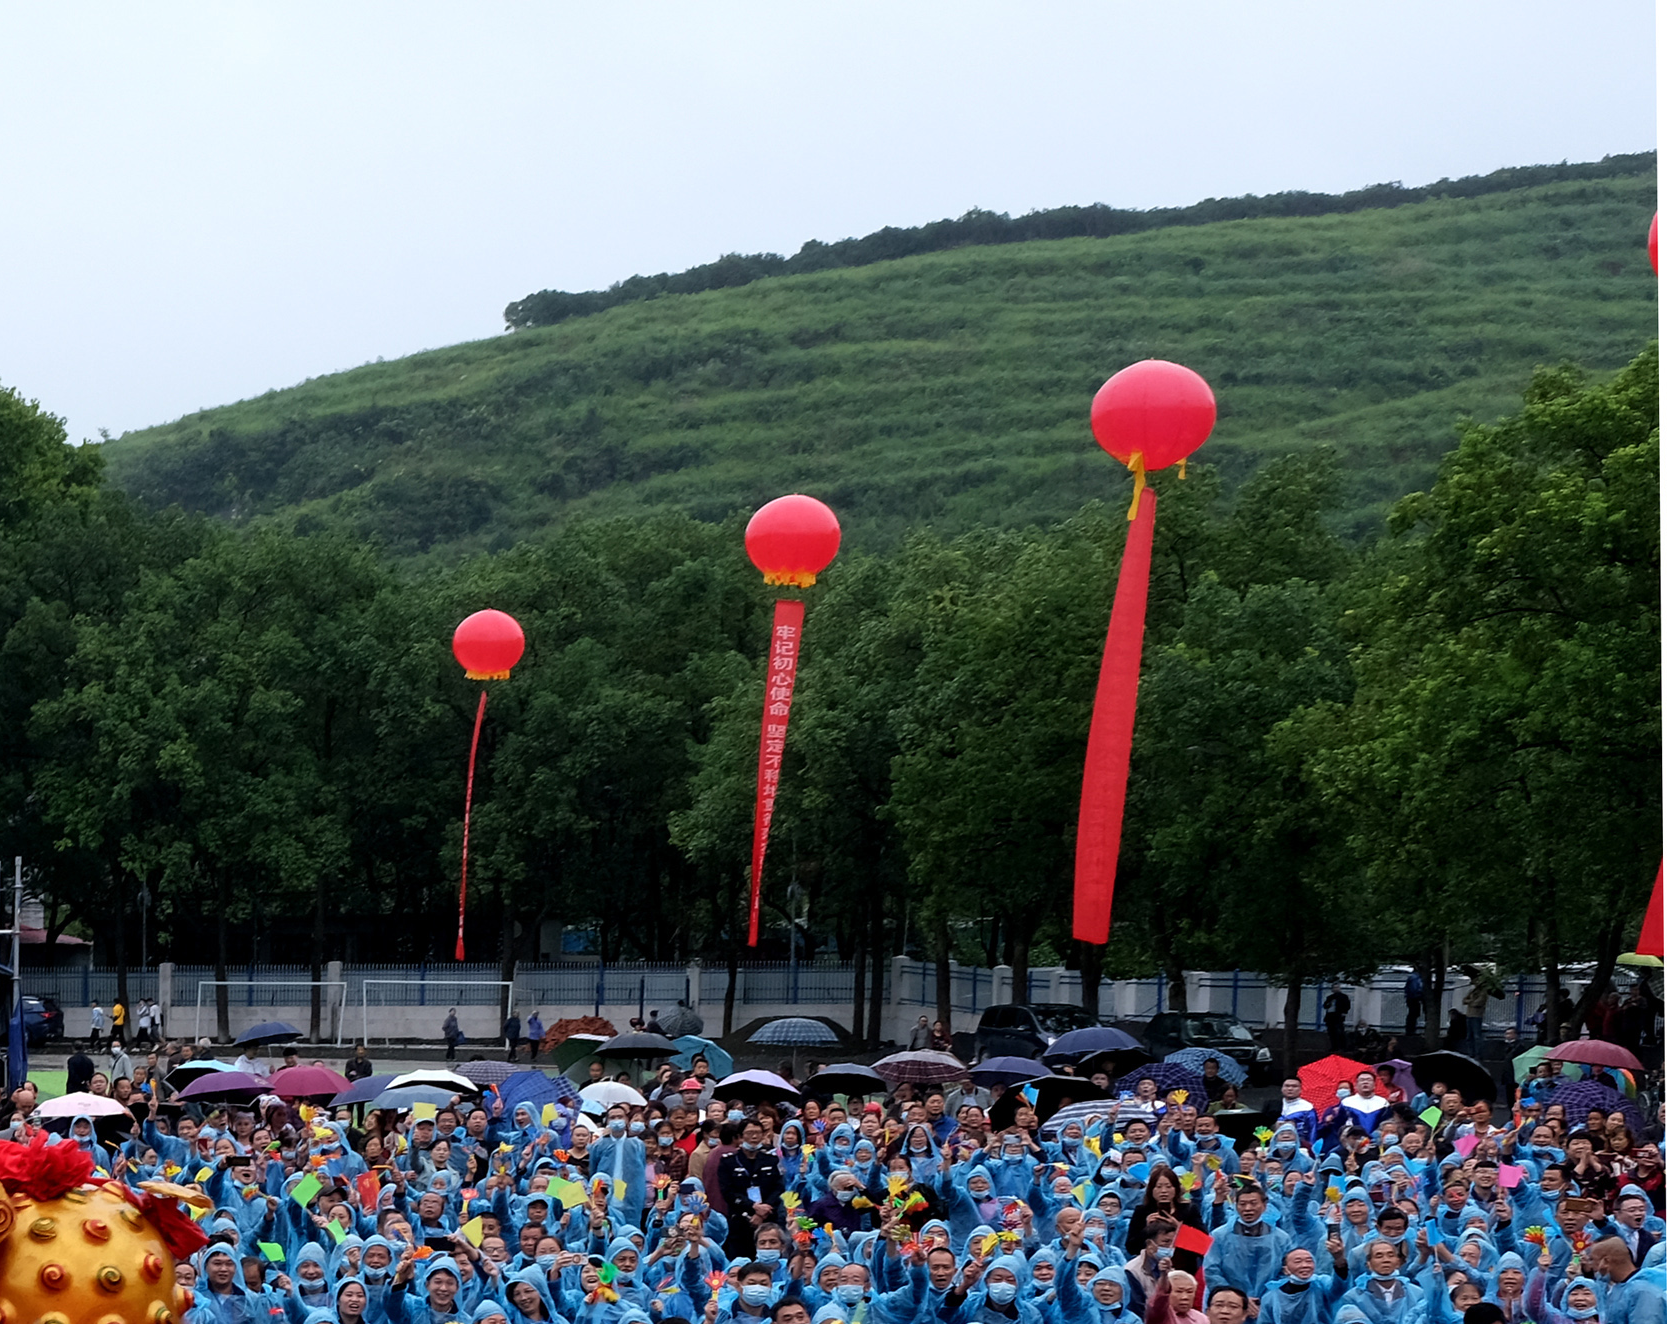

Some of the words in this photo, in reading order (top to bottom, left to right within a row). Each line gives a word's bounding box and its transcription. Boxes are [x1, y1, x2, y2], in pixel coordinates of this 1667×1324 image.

[770, 625, 796, 717] 牢记初心使命
